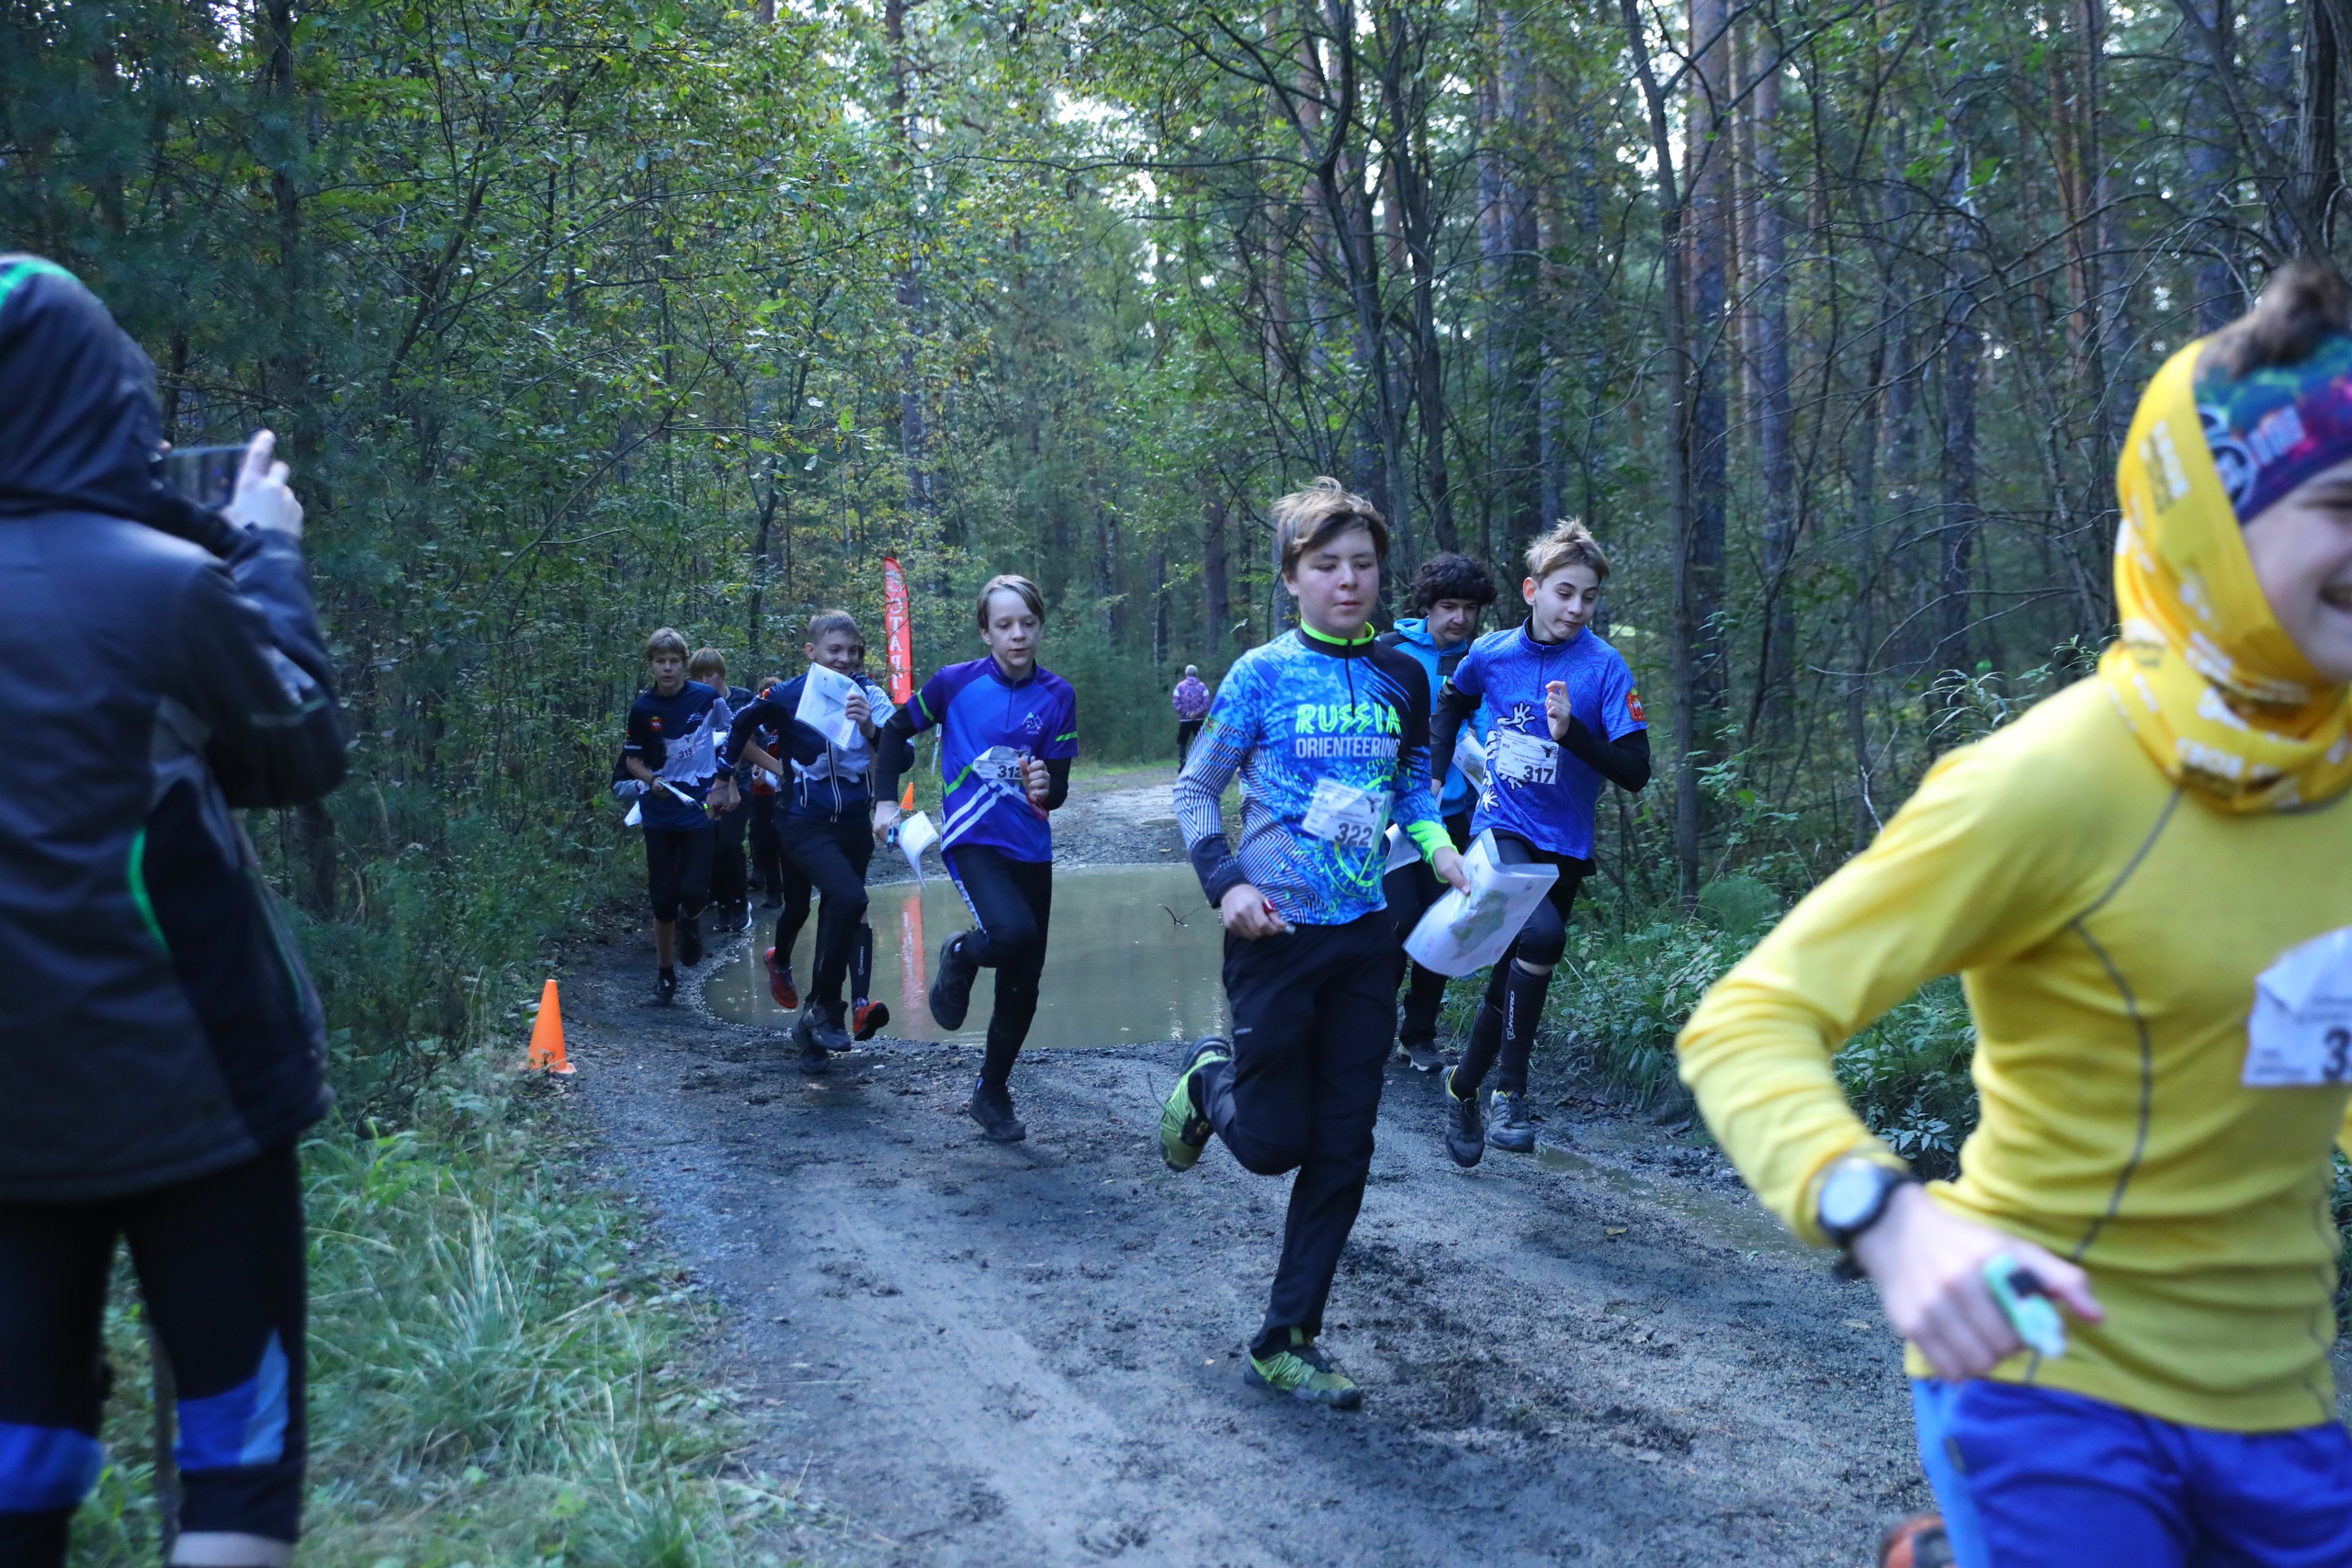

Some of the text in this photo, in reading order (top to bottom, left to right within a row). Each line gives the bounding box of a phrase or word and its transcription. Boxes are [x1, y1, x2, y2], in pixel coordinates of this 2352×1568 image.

[1295, 702, 1402, 735] RUSSIA
[678, 747, 694, 759] 315
[1295, 736, 1401, 759] ORIENTEERING
[1522, 765, 1555, 784] 317
[1334, 822, 1373, 846] 322
